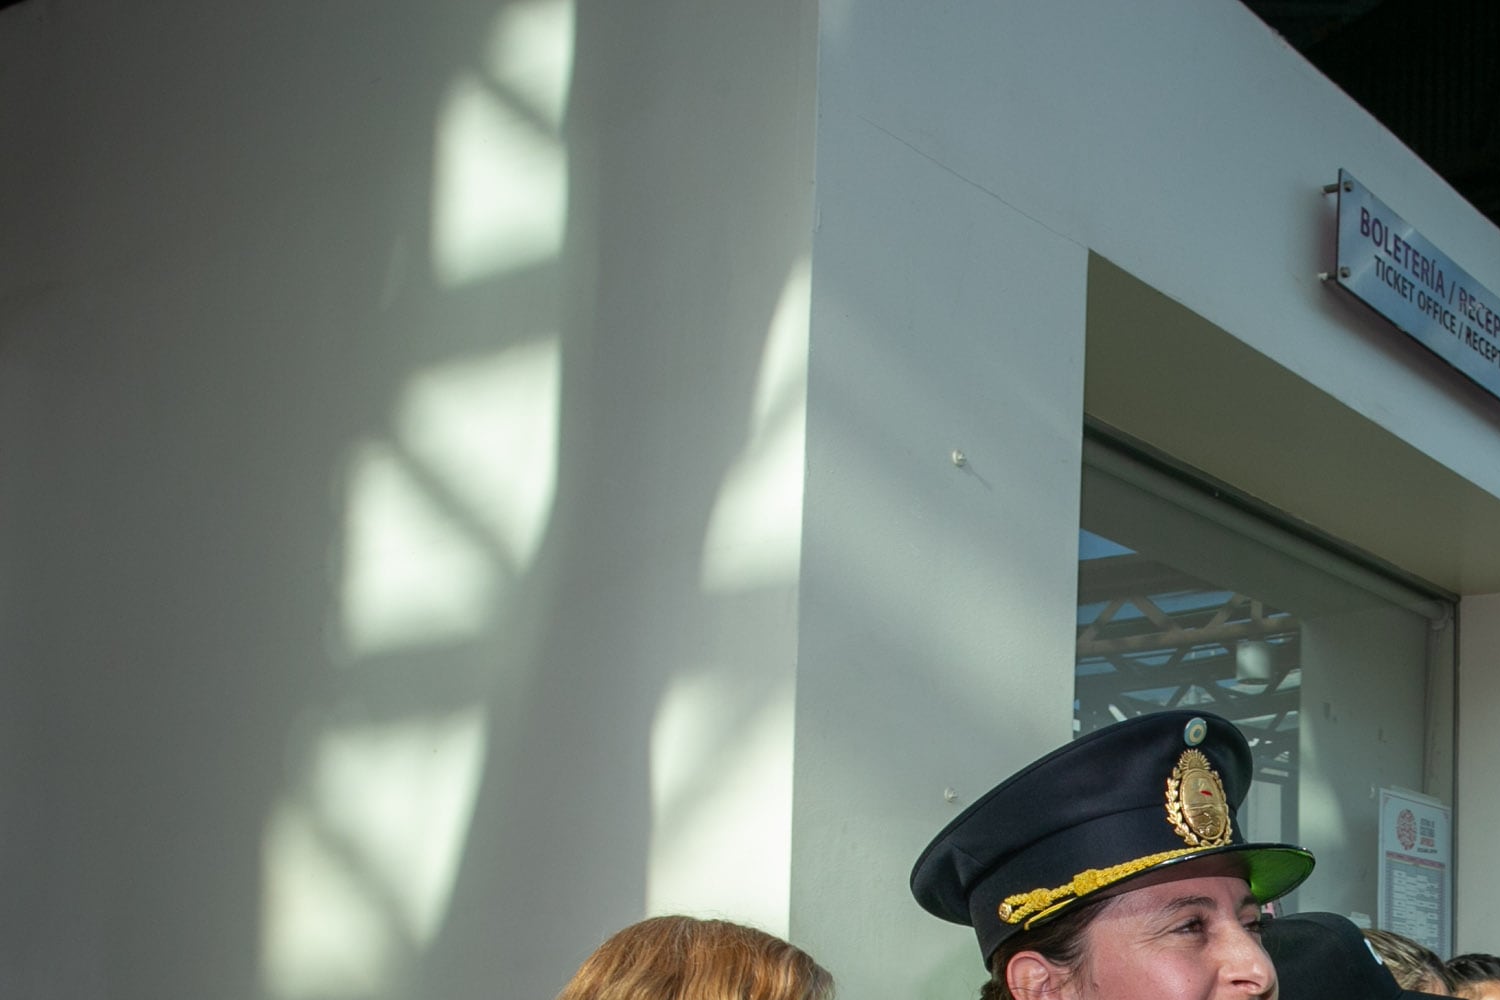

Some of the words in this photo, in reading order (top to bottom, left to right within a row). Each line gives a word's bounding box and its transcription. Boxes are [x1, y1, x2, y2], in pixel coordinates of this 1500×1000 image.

[1360, 206, 1445, 299] BOLETERÍA
[1448, 281, 1456, 305] /
[1374, 254, 1415, 303] TICKET
[1417, 290, 1456, 335] OFFICE
[1457, 322, 1464, 340] /
